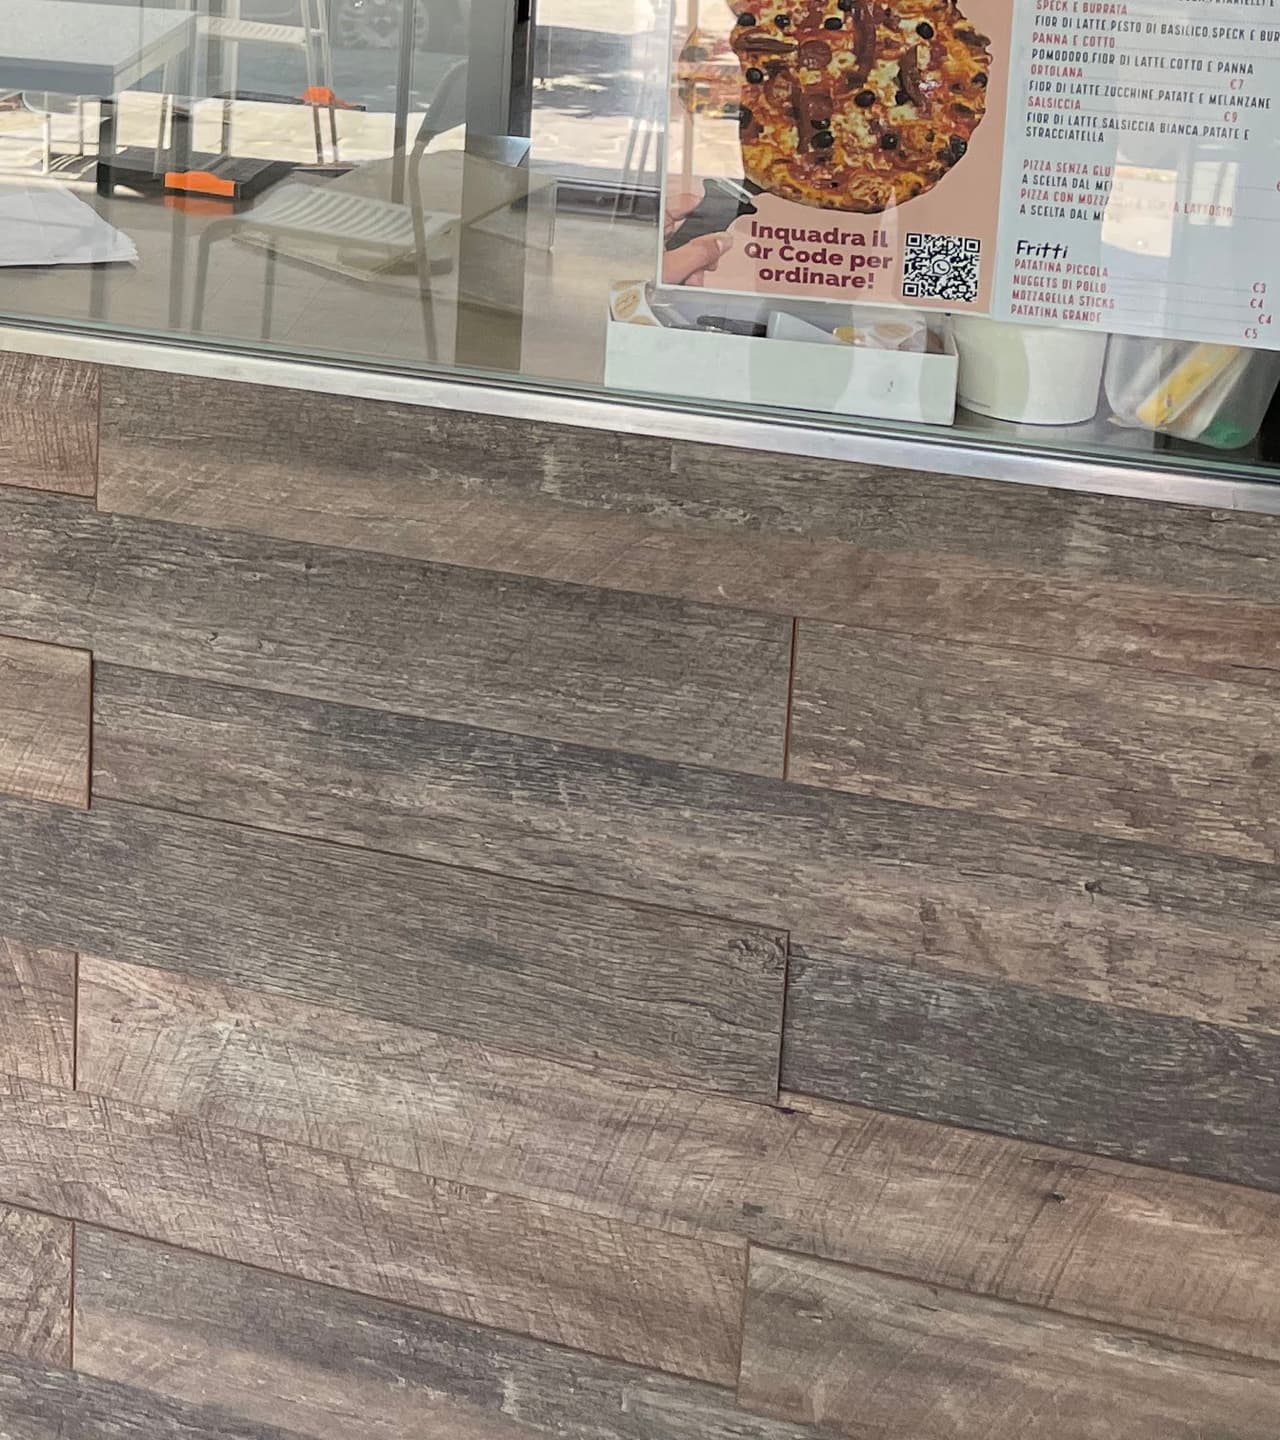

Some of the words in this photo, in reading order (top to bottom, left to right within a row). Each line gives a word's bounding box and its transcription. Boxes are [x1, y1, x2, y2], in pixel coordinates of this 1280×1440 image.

[1036, 0, 1068, 12] SPECK
[1073, 1, 1079, 13] E
[1083, 2, 1128, 16] BURRATA
[1035, 15, 1057, 27] FIOR
[1062, 17, 1072, 28] DI
[1146, 23, 1156, 34] DI
[1250, 29, 1256, 41] E
[1032, 31, 1068, 45] PANNA
[1073, 34, 1079, 46] E
[1083, 35, 1116, 48] COTTO
[1031, 64, 1083, 78] ORTOLANA
[1120, 54, 1130, 66] DI
[1207, 60, 1213, 73] E
[1218, 62, 1254, 75] PANNA
[1028, 96, 1081, 110] SALSICCIA
[1029, 80, 1051, 92] FIOR
[1056, 82, 1066, 93] DI
[1199, 93, 1204, 105] E
[1209, 94, 1271, 109] MELANZANE
[1026, 126, 1104, 142] STRACCIATELLA
[1027, 112, 1049, 124] FIOR
[1053, 113, 1064, 125] DI
[1244, 129, 1250, 141] E
[1023, 159, 1052, 171] PIZZA
[1056, 162, 1088, 175] SENZA
[1022, 174, 1028, 184] A
[1033, 174, 1067, 188] SCELTA
[1072, 178, 1090, 190] DAL
[1020, 188, 1049, 201] PIZZA
[1053, 191, 1073, 203] CON
[1020, 204, 1026, 215] A
[1030, 205, 1065, 218] SCELTA
[1070, 208, 1088, 221] DAL
[751, 221, 866, 245] Inquadra
[872, 230, 888, 248] il
[744, 242, 773, 259] Qr
[779, 245, 844, 265] Code
[850, 254, 893, 271] per
[1016, 239, 1069, 260] Fritti
[1014, 258, 1062, 274] PATATINA
[1066, 264, 1109, 278] PICCOLA
[759, 267, 875, 289] ordinare!
[1013, 274, 1058, 289] NUGGETS
[1062, 278, 1073, 290] DI
[1076, 280, 1107, 293] POLLO
[1011, 289, 1074, 305] MOZZARELLA
[1078, 295, 1115, 310] STICKS
[1010, 304, 1058, 320] PATATINA
[1062, 309, 1102, 323] GRANDE
